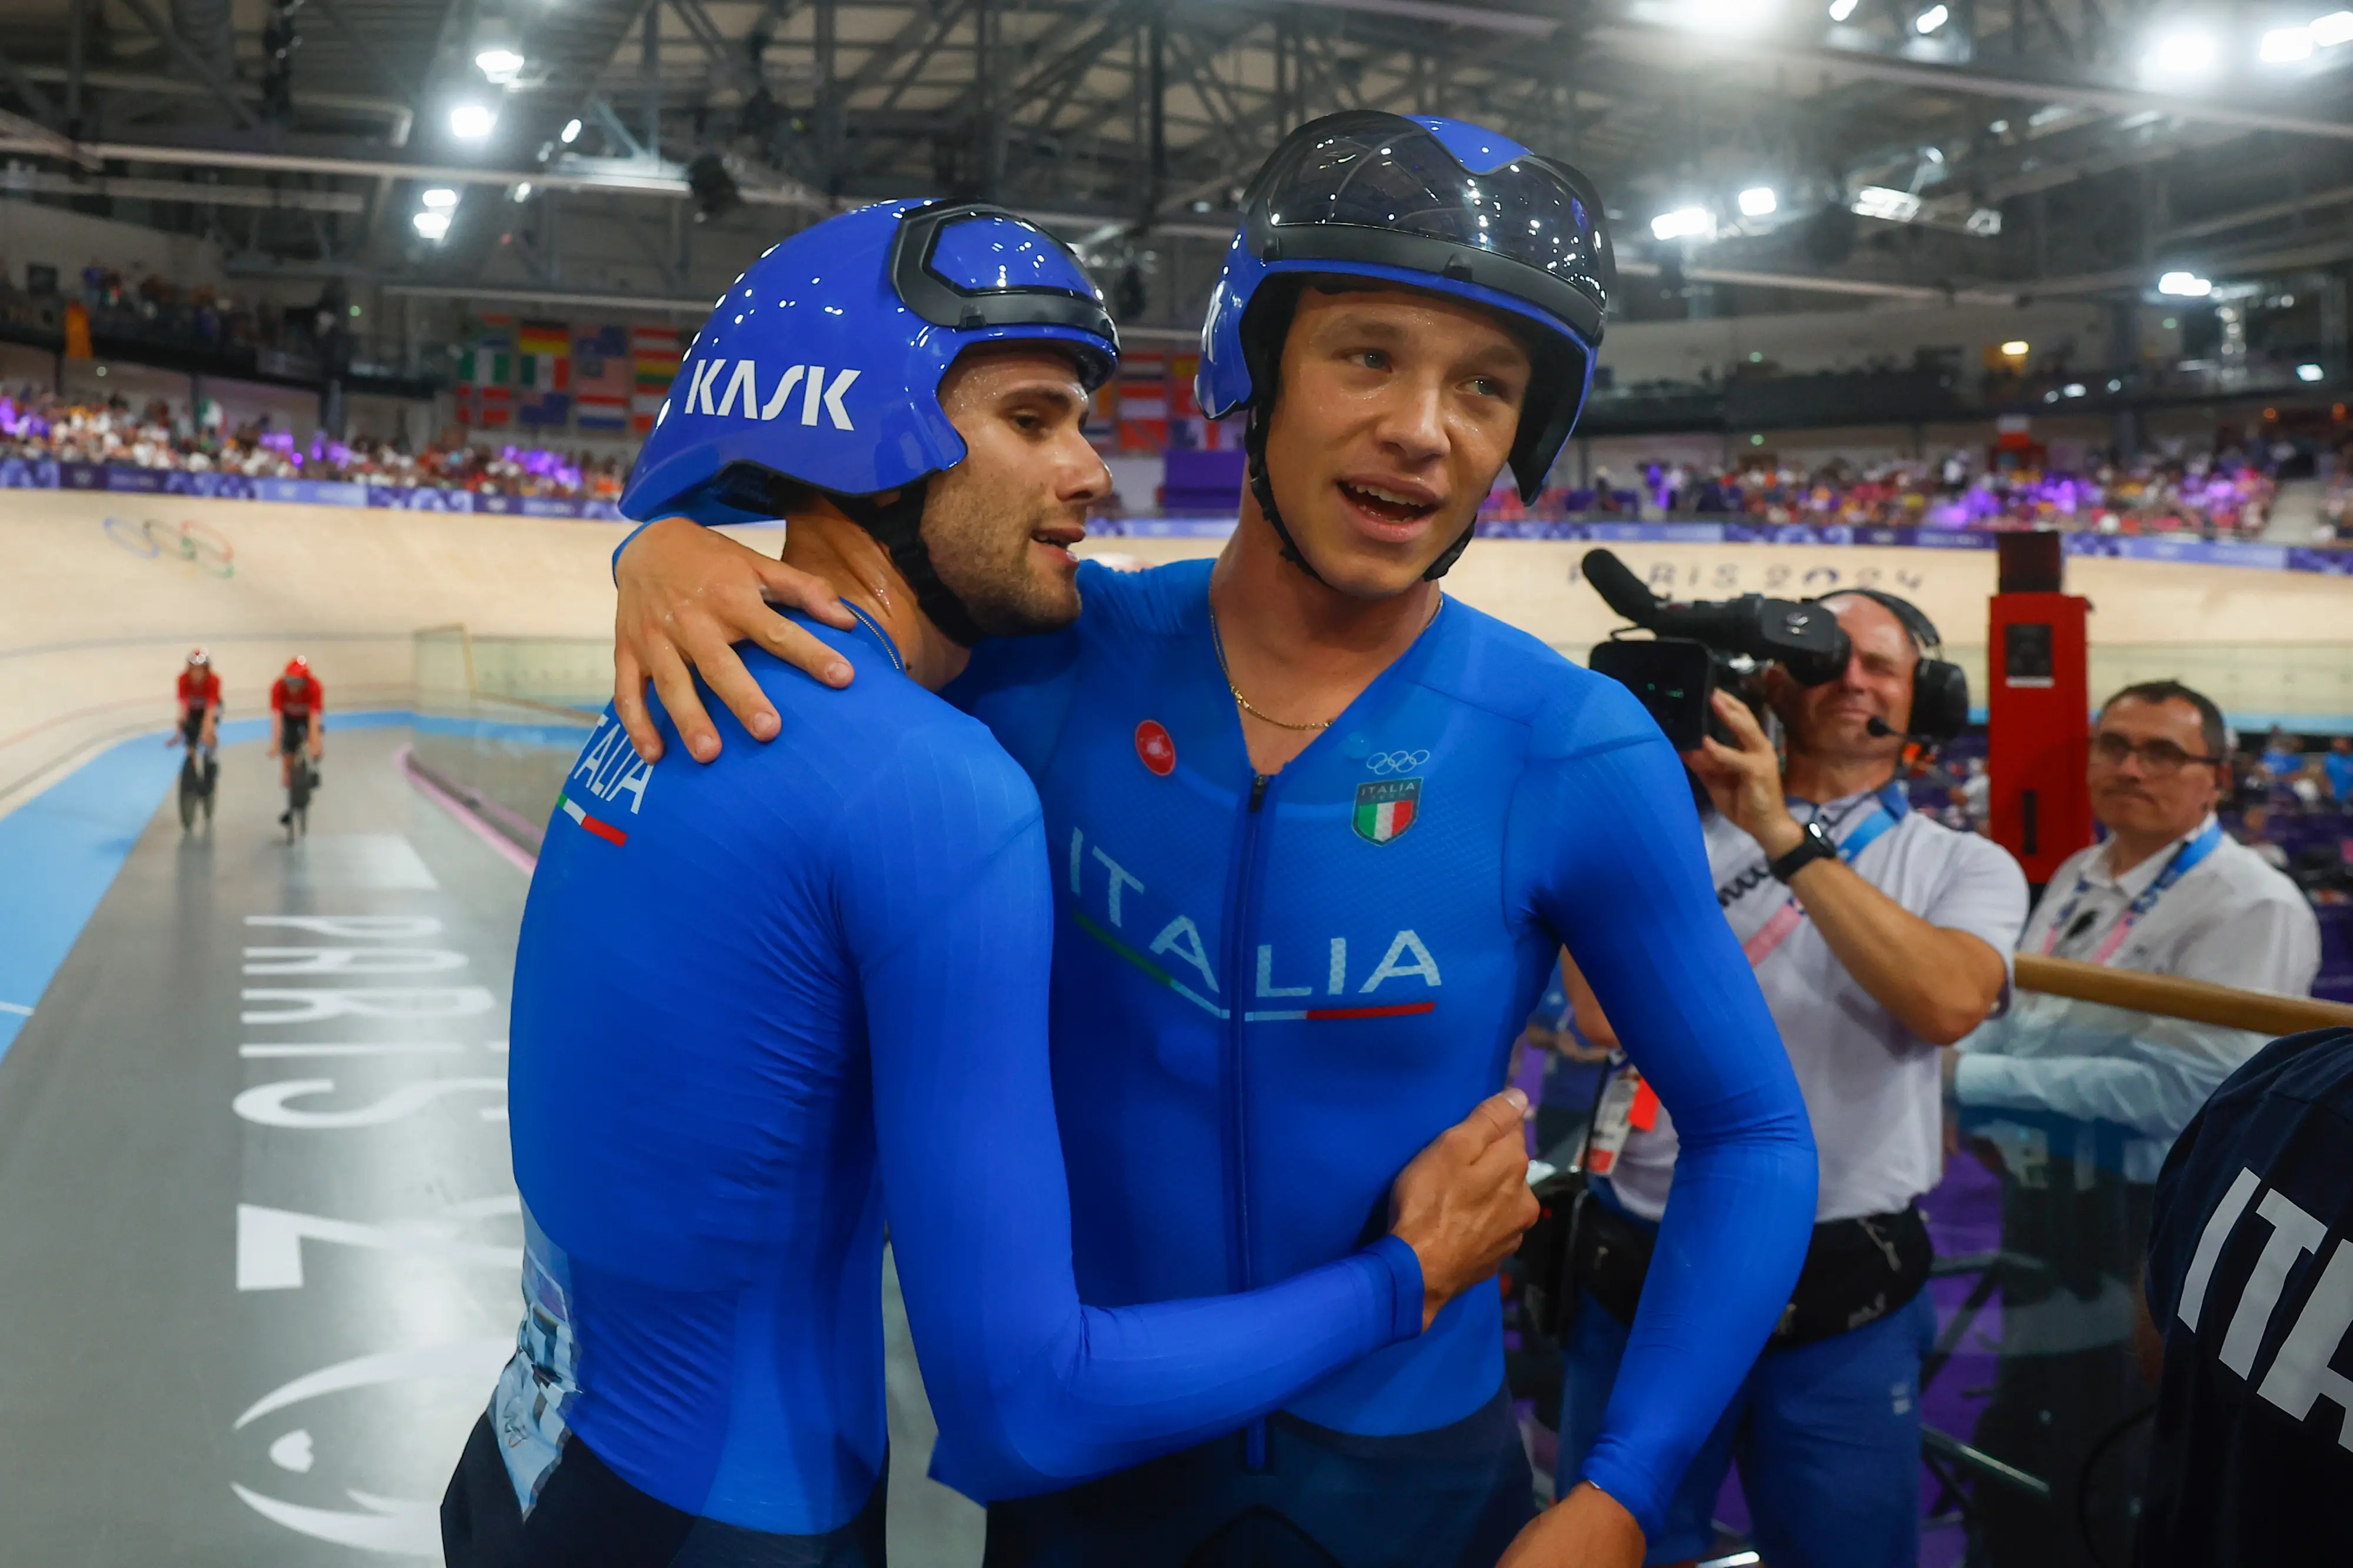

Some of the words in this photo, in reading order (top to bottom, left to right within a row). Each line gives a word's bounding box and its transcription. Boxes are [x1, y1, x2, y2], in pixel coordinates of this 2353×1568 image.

[685, 358, 861, 431] KASK
[1568, 562, 1739, 588] PRIS
[1361, 782, 1415, 796] ITALIA
[1069, 826, 1442, 998] ITALIA
